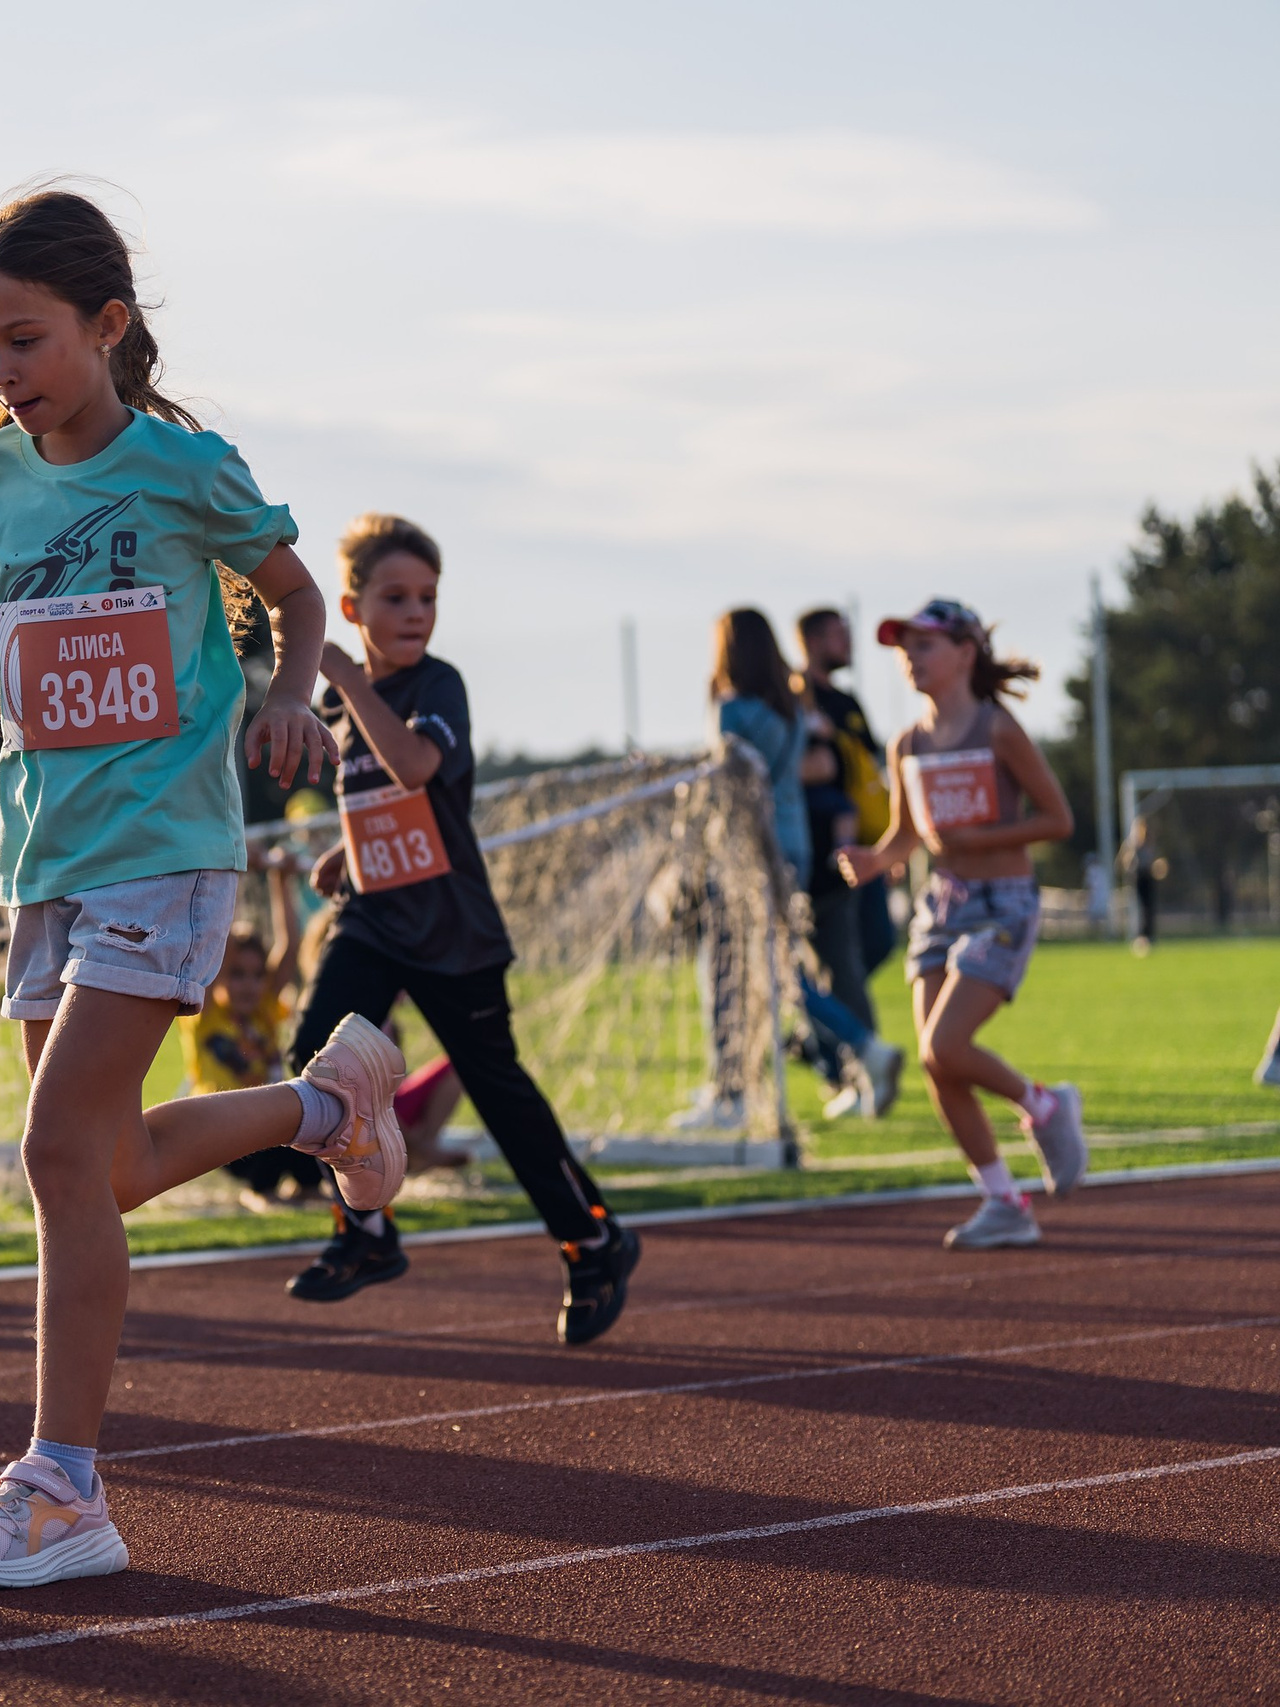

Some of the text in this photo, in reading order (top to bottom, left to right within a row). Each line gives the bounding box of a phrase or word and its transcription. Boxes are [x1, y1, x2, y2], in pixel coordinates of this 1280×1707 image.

[20, 608, 37, 616] СПОРТ
[115, 597, 134, 609] Пэй
[58, 632, 125, 662] АЛИСА
[40, 663, 159, 731] 3348
[361, 829, 434, 881] 4813
[32, 1473, 60, 1491] Nordman
